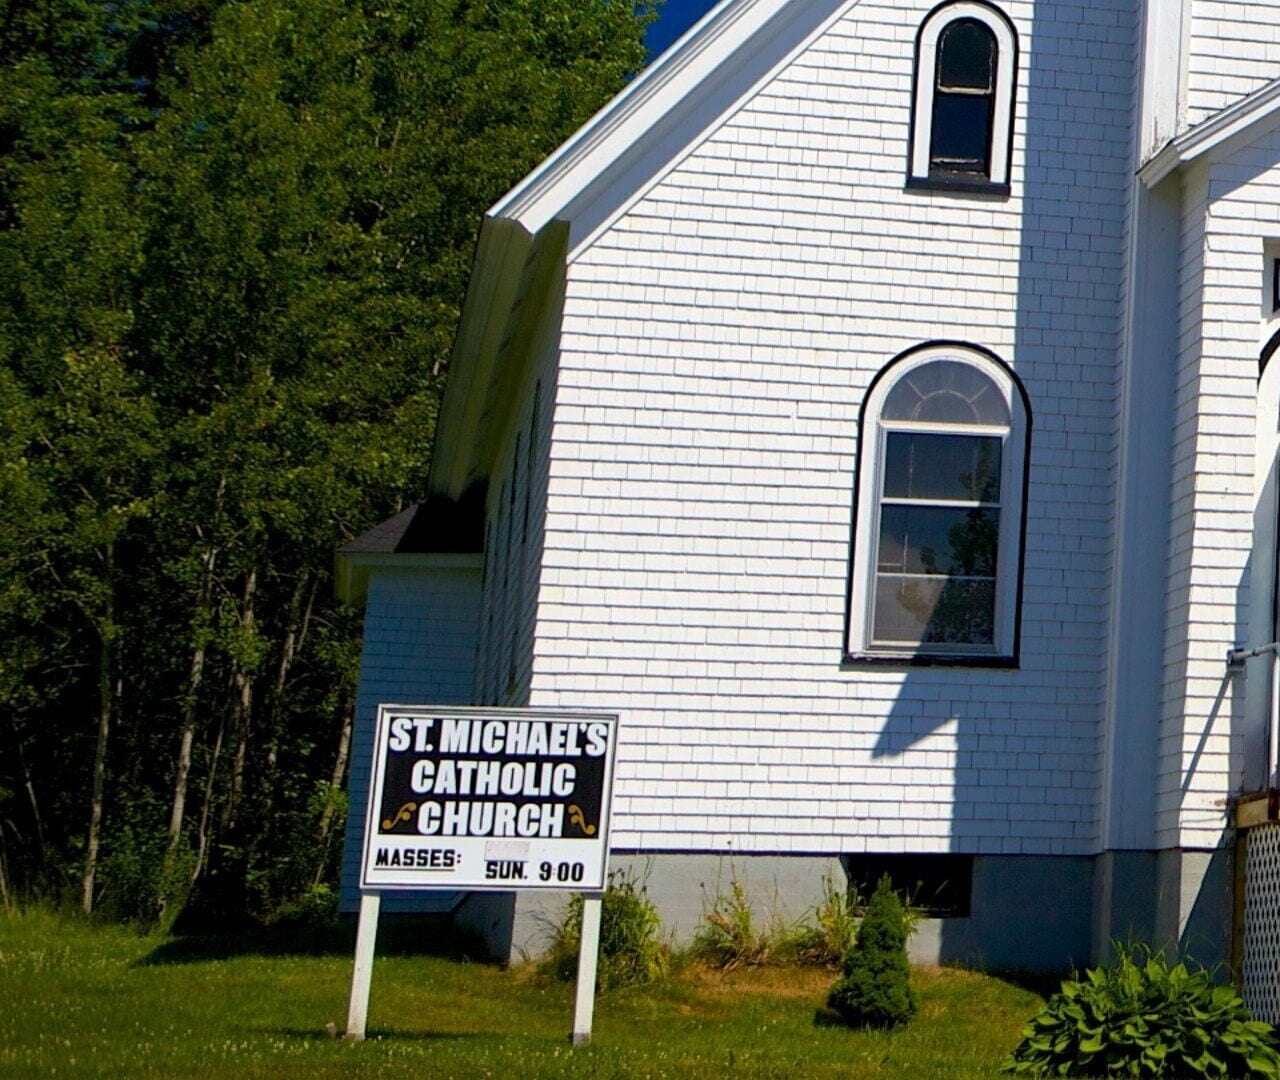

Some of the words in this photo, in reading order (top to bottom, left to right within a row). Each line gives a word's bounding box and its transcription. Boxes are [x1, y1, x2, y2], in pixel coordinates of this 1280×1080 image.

[389, 717, 434, 753] ST.
[438, 719, 608, 757] MICHAEL'S
[411, 759, 577, 797] CATHOLIC
[416, 800, 565, 838] CHURCH
[375, 847, 463, 868] MASSES:
[485, 860, 528, 880] SUN.
[539, 861, 585, 882] 9:00
